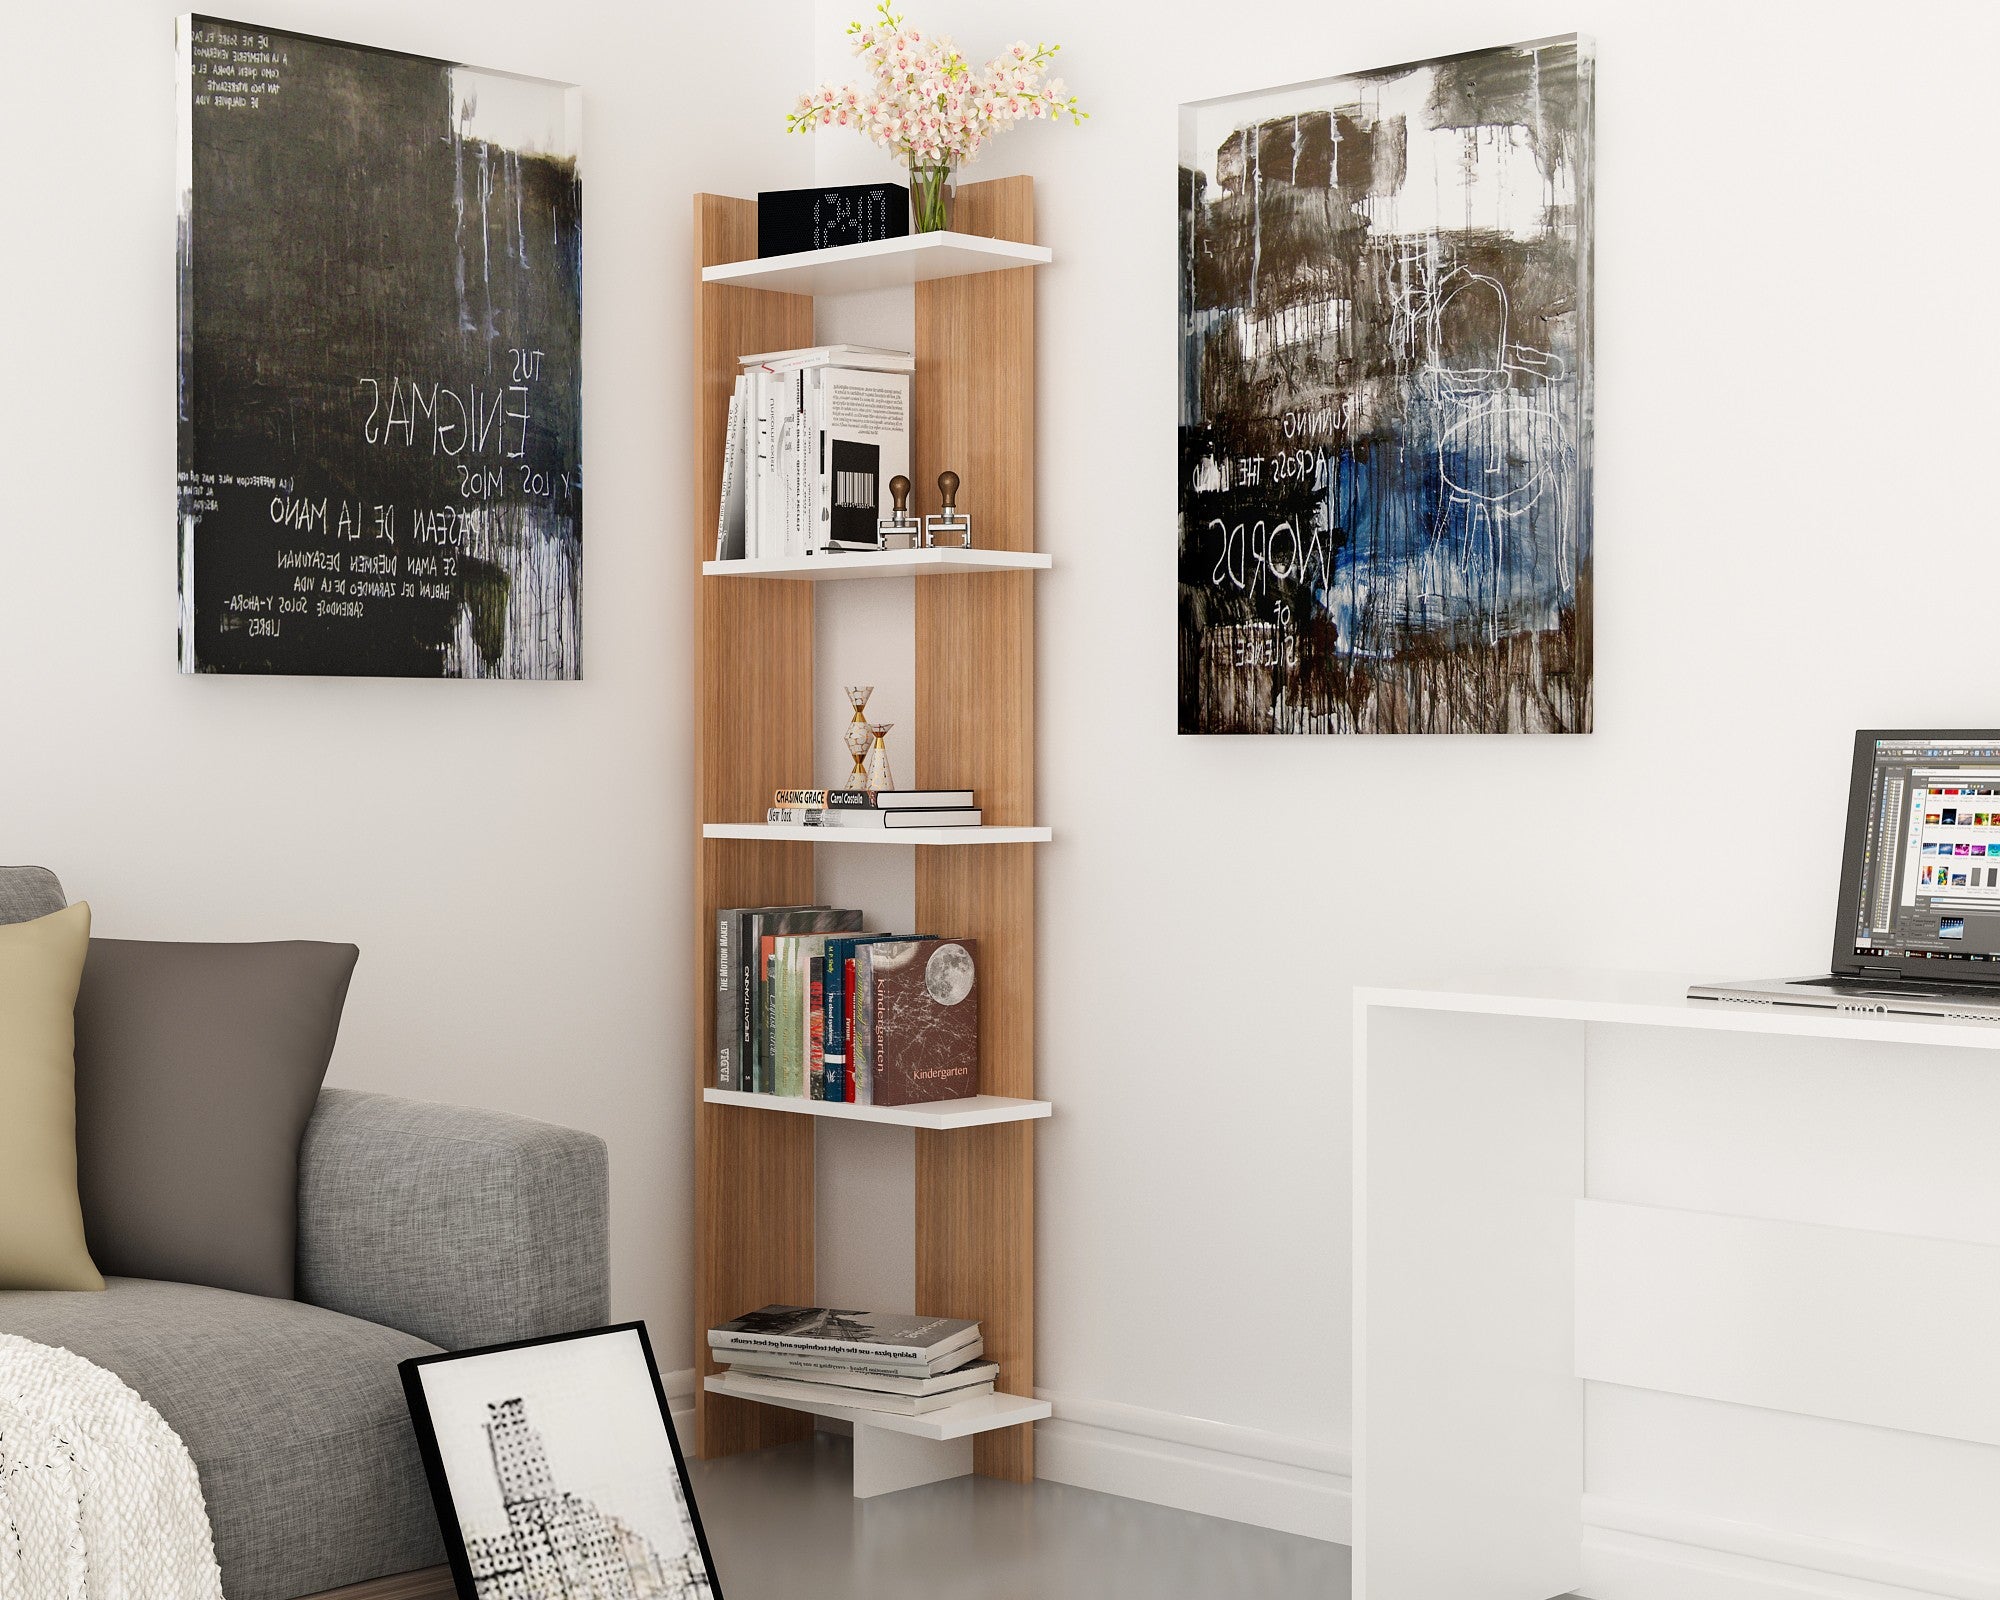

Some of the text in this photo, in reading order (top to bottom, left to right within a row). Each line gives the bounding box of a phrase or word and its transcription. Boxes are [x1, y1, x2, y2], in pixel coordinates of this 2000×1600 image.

[776, 791, 803, 804] CHASING
[804, 791, 825, 804] GRACE
[720, 921, 728, 946] MAKER
[720, 948, 728, 977] MOTION
[720, 978, 728, 991] THE
[876, 978, 885, 1072] Kindergarten
[913, 1066, 968, 1080] Kindergarten
